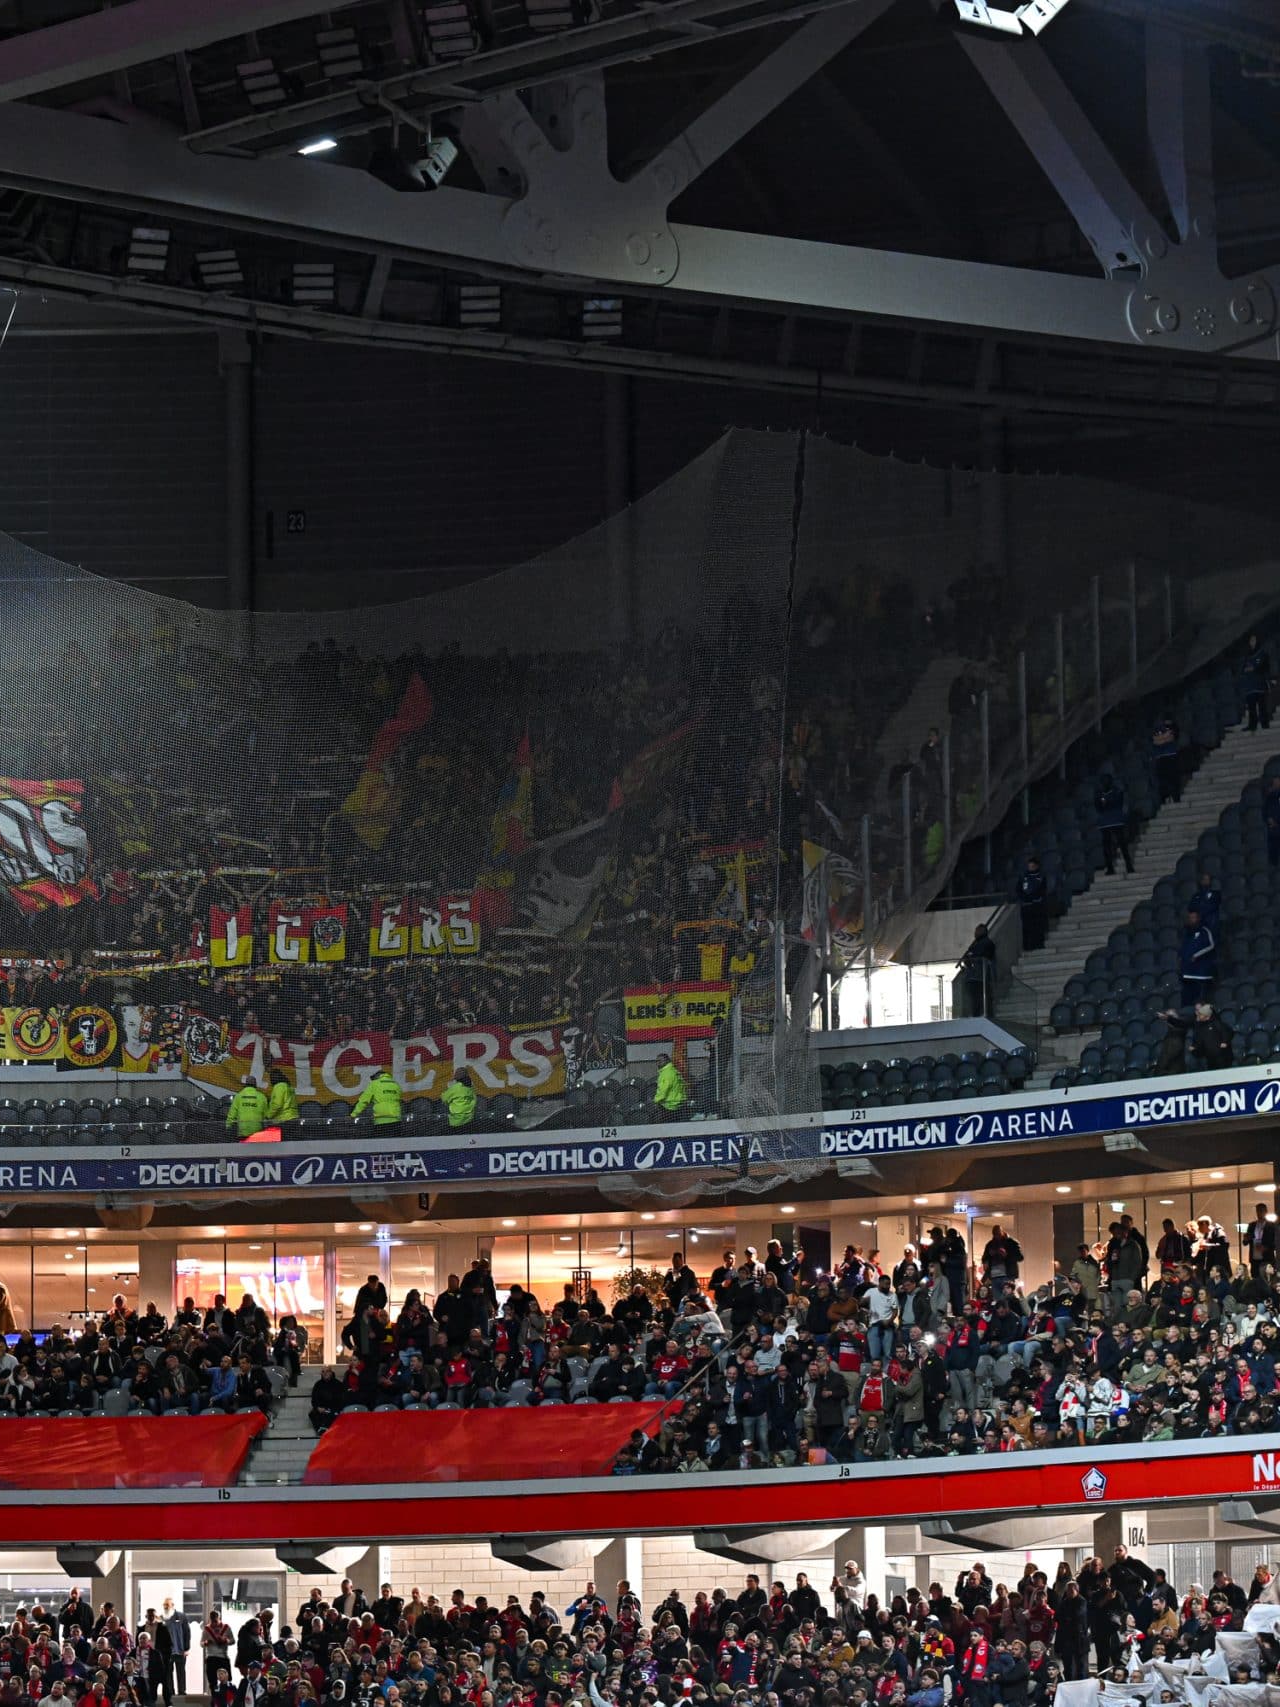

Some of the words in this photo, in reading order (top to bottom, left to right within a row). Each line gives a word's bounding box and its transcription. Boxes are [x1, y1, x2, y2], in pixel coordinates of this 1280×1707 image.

[287, 513, 305, 531] 23
[627, 1003, 667, 1020] LENS
[685, 1001, 728, 1017] PACA
[236, 1028, 563, 1097] TIGERS
[850, 1109, 866, 1121] J21
[1124, 1088, 1246, 1124] DECATHLON
[821, 1121, 947, 1154] DECATHLON
[988, 1108, 1074, 1139] ARENA
[489, 1146, 624, 1175] DECATHLON
[671, 1135, 765, 1164] ARENA
[139, 1161, 282, 1186] DECATHLON
[331, 1156, 429, 1181] ARENA
[839, 1465, 851, 1478] Ja
